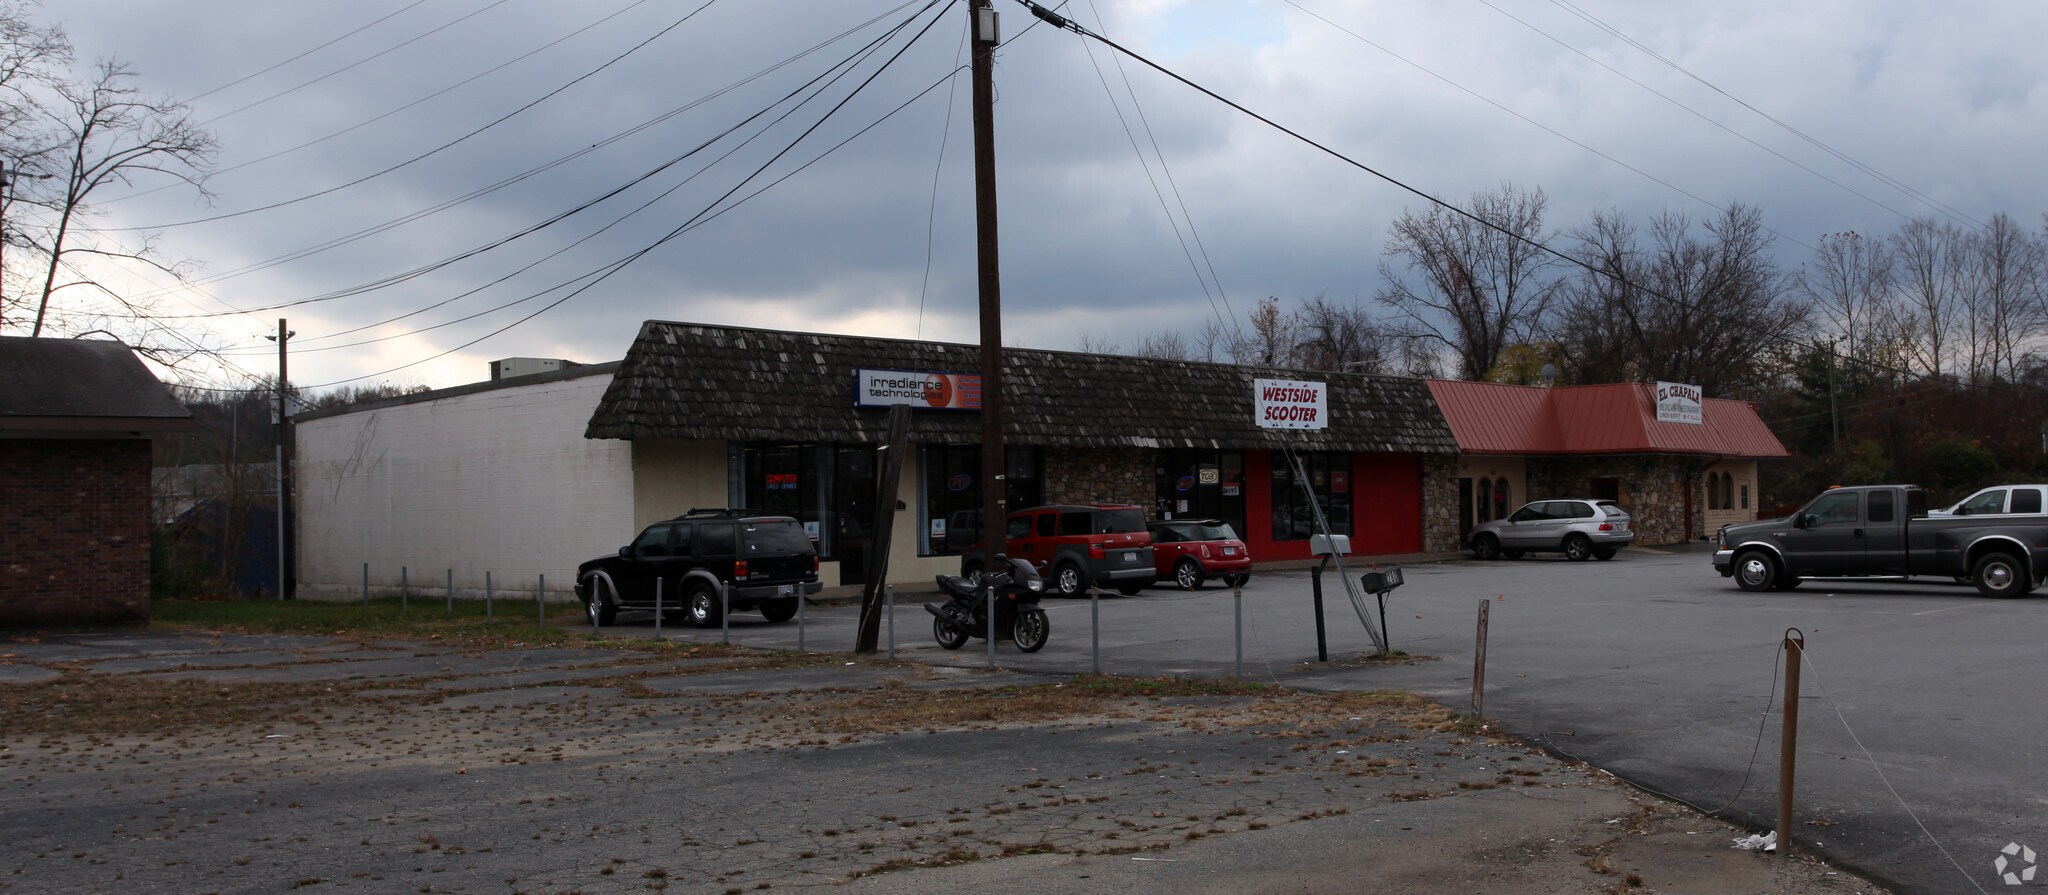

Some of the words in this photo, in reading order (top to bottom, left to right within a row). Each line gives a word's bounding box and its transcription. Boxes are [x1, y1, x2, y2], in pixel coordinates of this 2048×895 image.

[870, 376, 943, 390] irradiance
[869, 388, 944, 400] technologies
[1263, 387, 1318, 403] WESTSIDE
[1658, 388, 1668, 402] EL
[1669, 385, 1700, 405] CHAPALA
[1264, 405, 1317, 422] SCOOTER
[766, 473, 798, 483] COMPUTER
